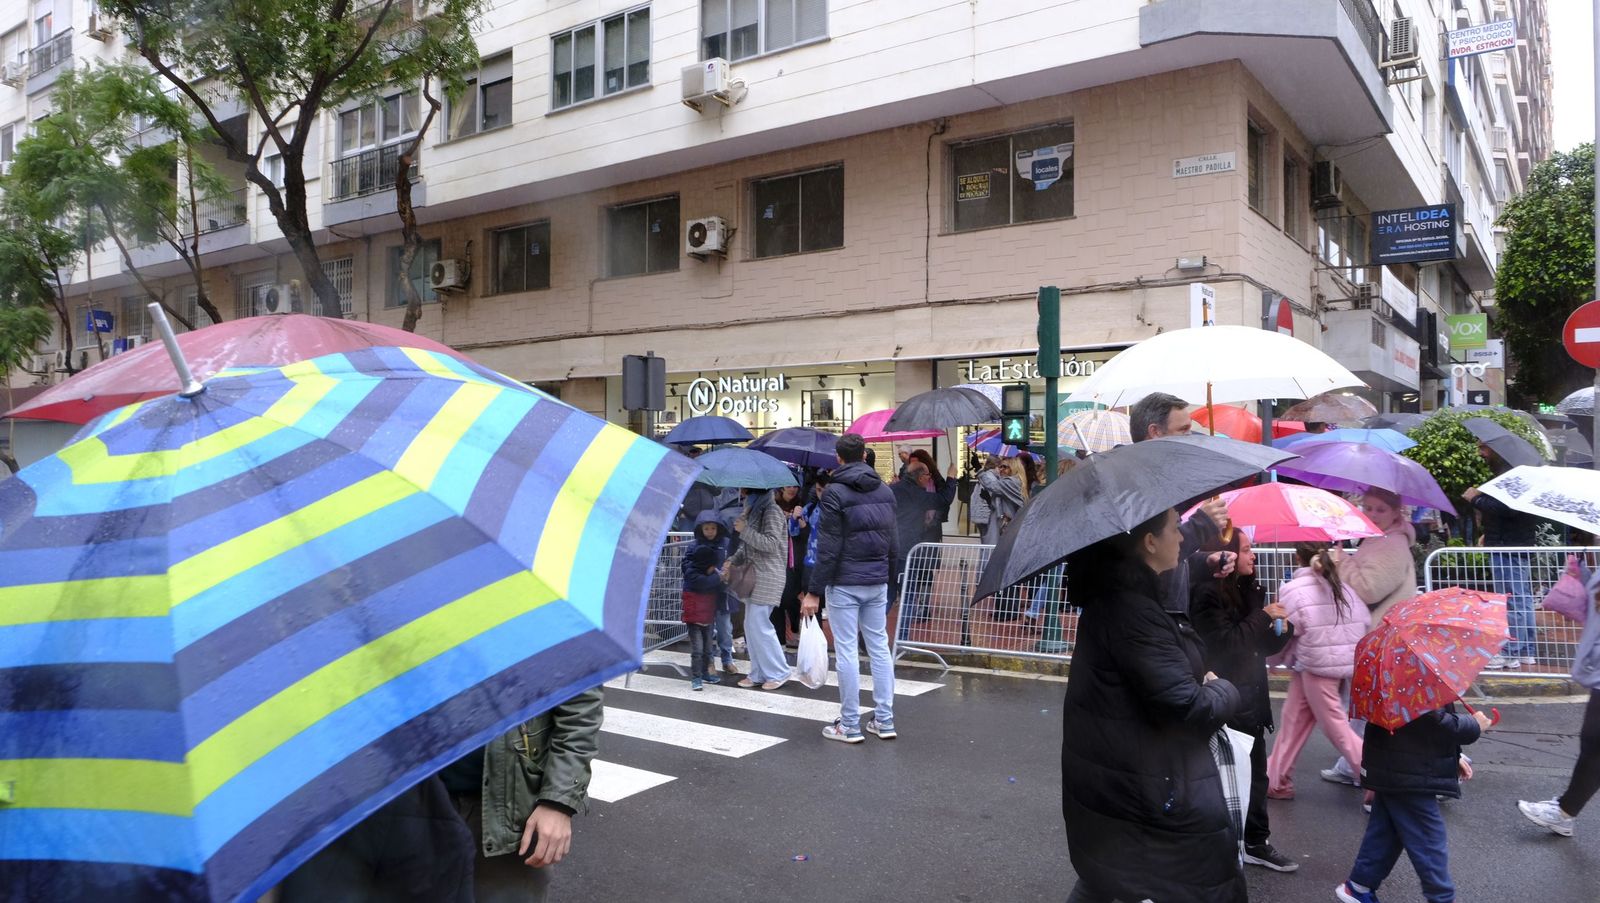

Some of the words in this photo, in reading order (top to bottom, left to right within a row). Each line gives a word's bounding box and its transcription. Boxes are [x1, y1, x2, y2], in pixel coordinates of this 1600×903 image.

[1450, 28, 1481, 39] CENTRO
[1459, 30, 1512, 45] PSICOLOGICO
[1450, 45, 1474, 55] AVDA.
[1476, 37, 1514, 50] ESTACION
[1035, 165, 1059, 174] locales
[1175, 165, 1203, 176] MAESTRO
[1205, 161, 1232, 171] PADILLA
[1377, 208, 1450, 225] INTELIDEA
[1378, 225, 1402, 235] ERA
[1404, 219, 1450, 232] HOSTING
[1450, 321, 1482, 336] VOX
[969, 359, 992, 381] La
[999, 356, 1095, 380] Estaión
[719, 373, 785, 394] Natural
[719, 395, 779, 417] Optics
